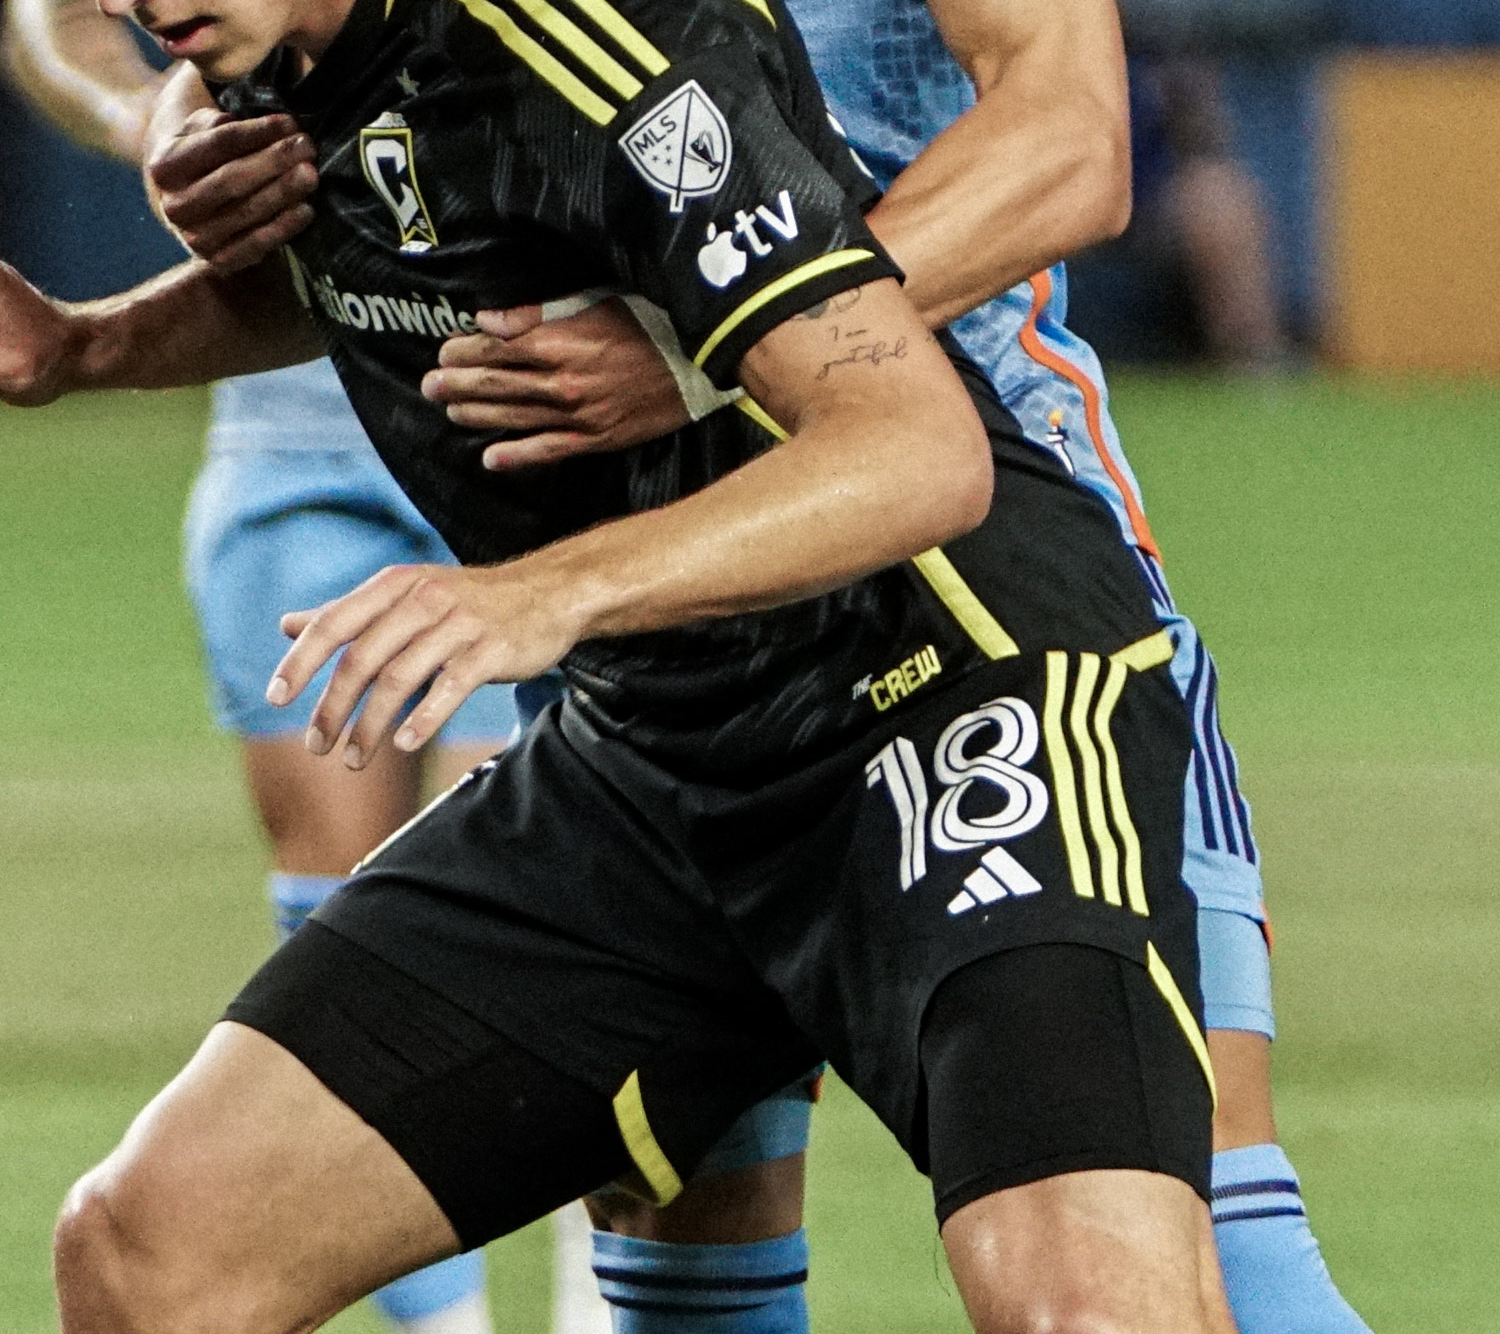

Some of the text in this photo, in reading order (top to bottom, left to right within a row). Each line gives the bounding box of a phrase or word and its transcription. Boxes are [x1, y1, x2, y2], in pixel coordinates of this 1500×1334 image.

[633, 114, 677, 156] MLS
[734, 189, 799, 257] tv
[313, 274, 484, 339] tionwide
[870, 644, 943, 712] CREW
[865, 696, 1050, 892] 18
